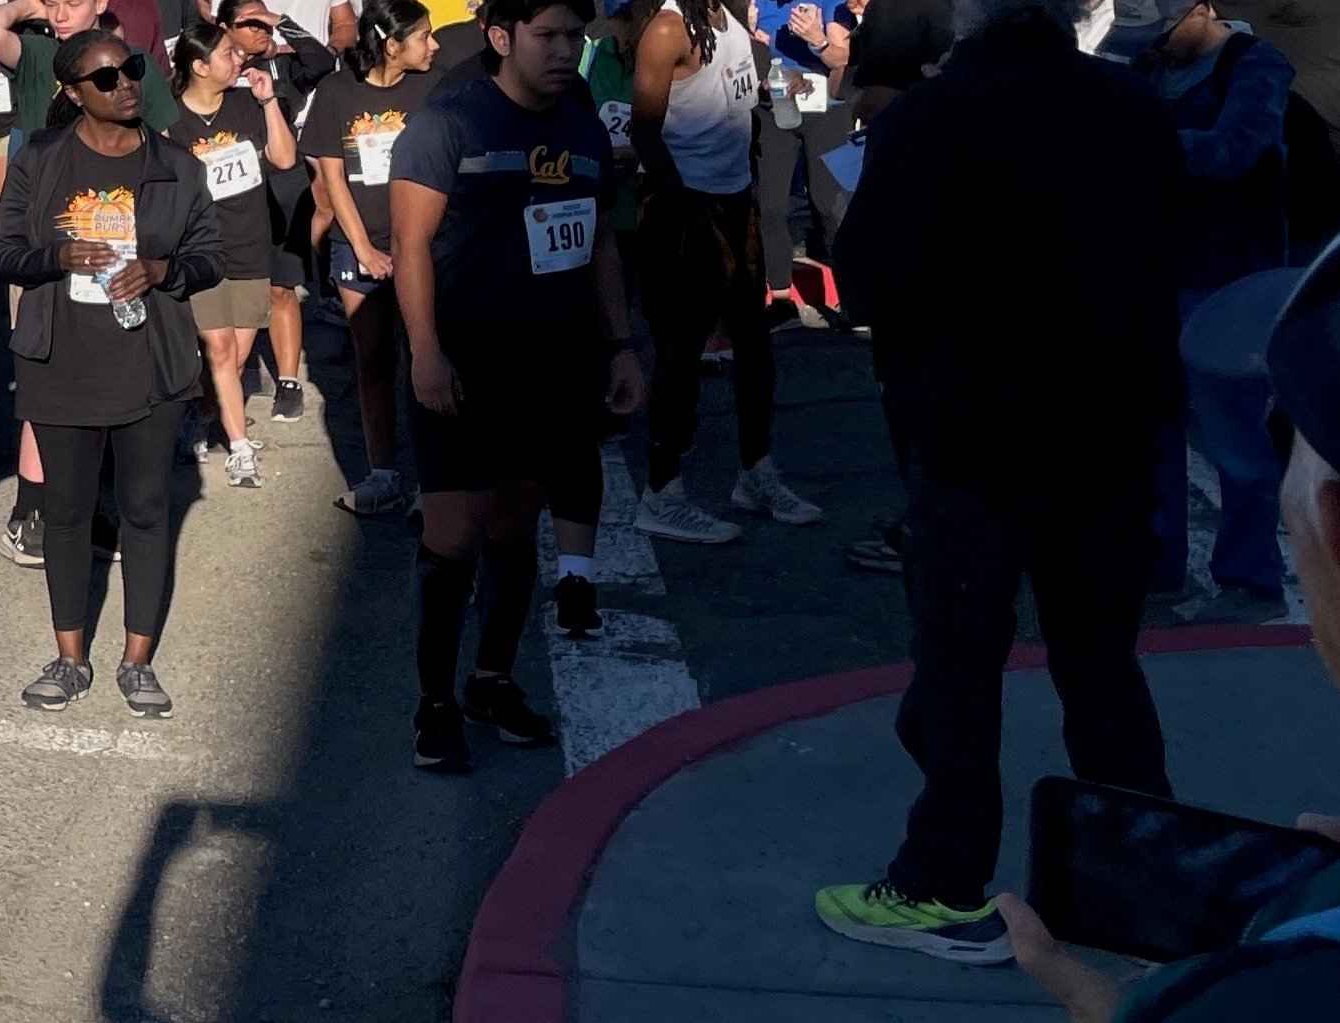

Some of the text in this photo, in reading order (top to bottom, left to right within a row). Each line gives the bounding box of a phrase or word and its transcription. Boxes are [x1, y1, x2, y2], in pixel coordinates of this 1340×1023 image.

[732, 73, 752, 100] 244
[212, 159, 248, 185] 271
[529, 145, 570, 184] Cal
[546, 221, 585, 252] 190
